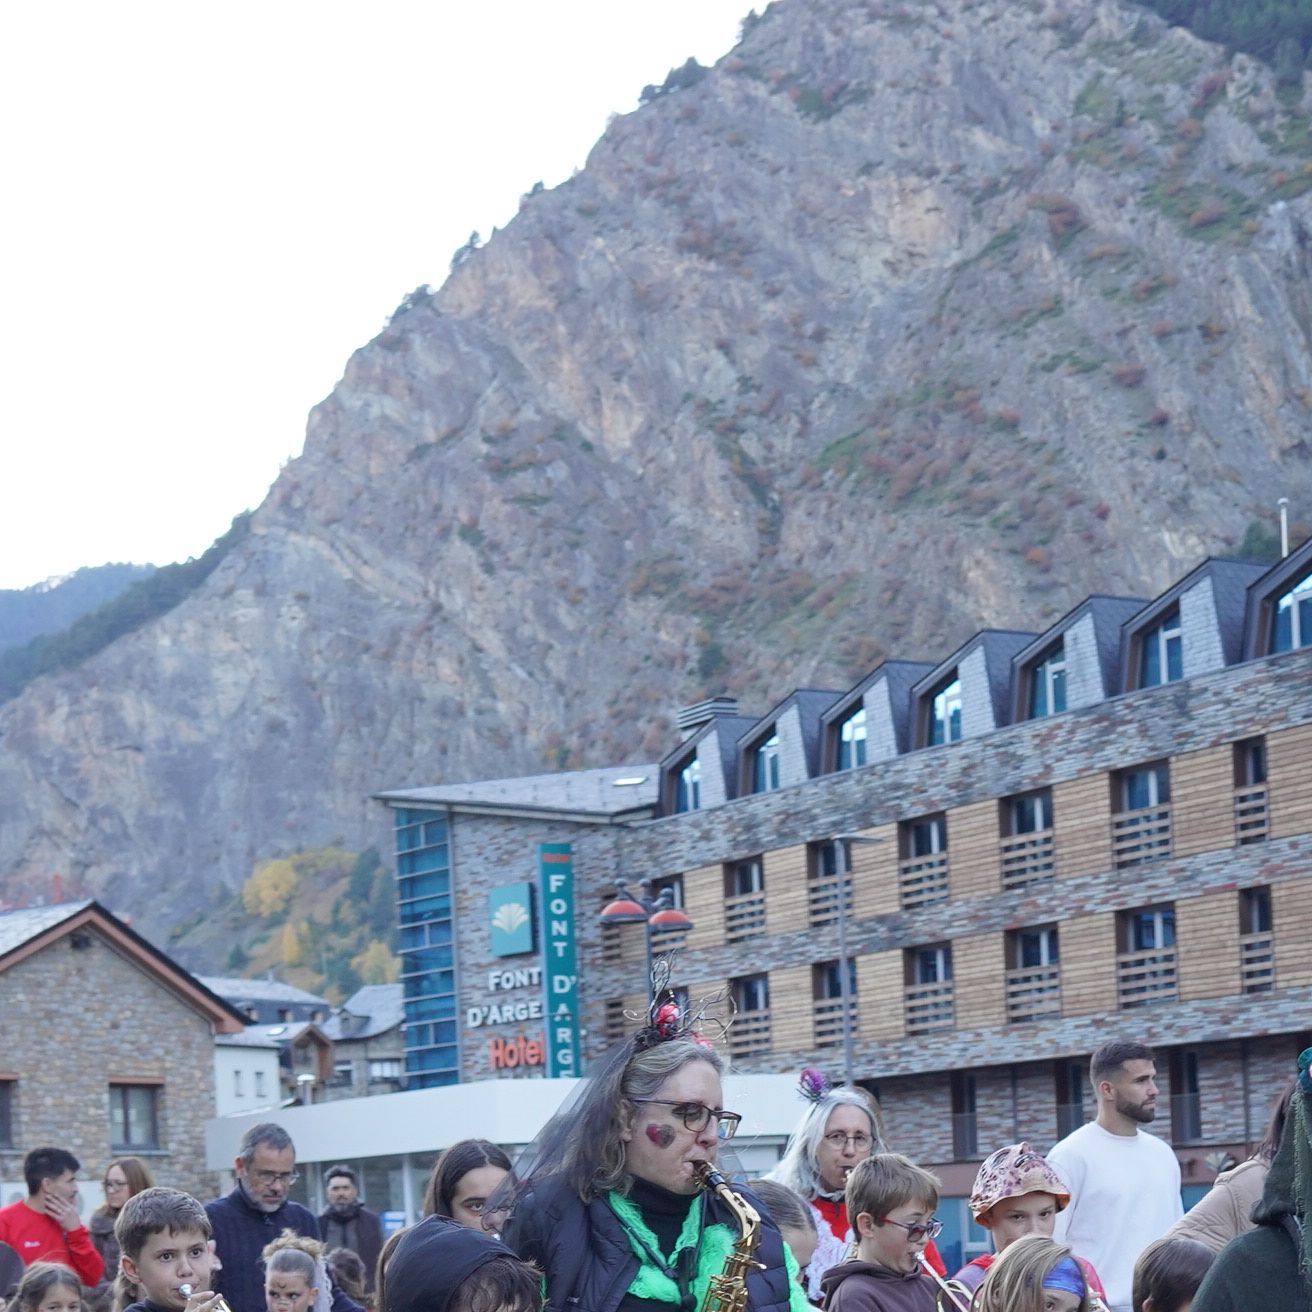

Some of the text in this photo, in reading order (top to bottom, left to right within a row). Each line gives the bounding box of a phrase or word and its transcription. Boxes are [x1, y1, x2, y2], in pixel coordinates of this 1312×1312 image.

[548, 874, 568, 959] FONT
[489, 967, 542, 991] FONT
[467, 1001, 543, 1028] D'ARGE
[490, 1031, 546, 1071] Hotel
